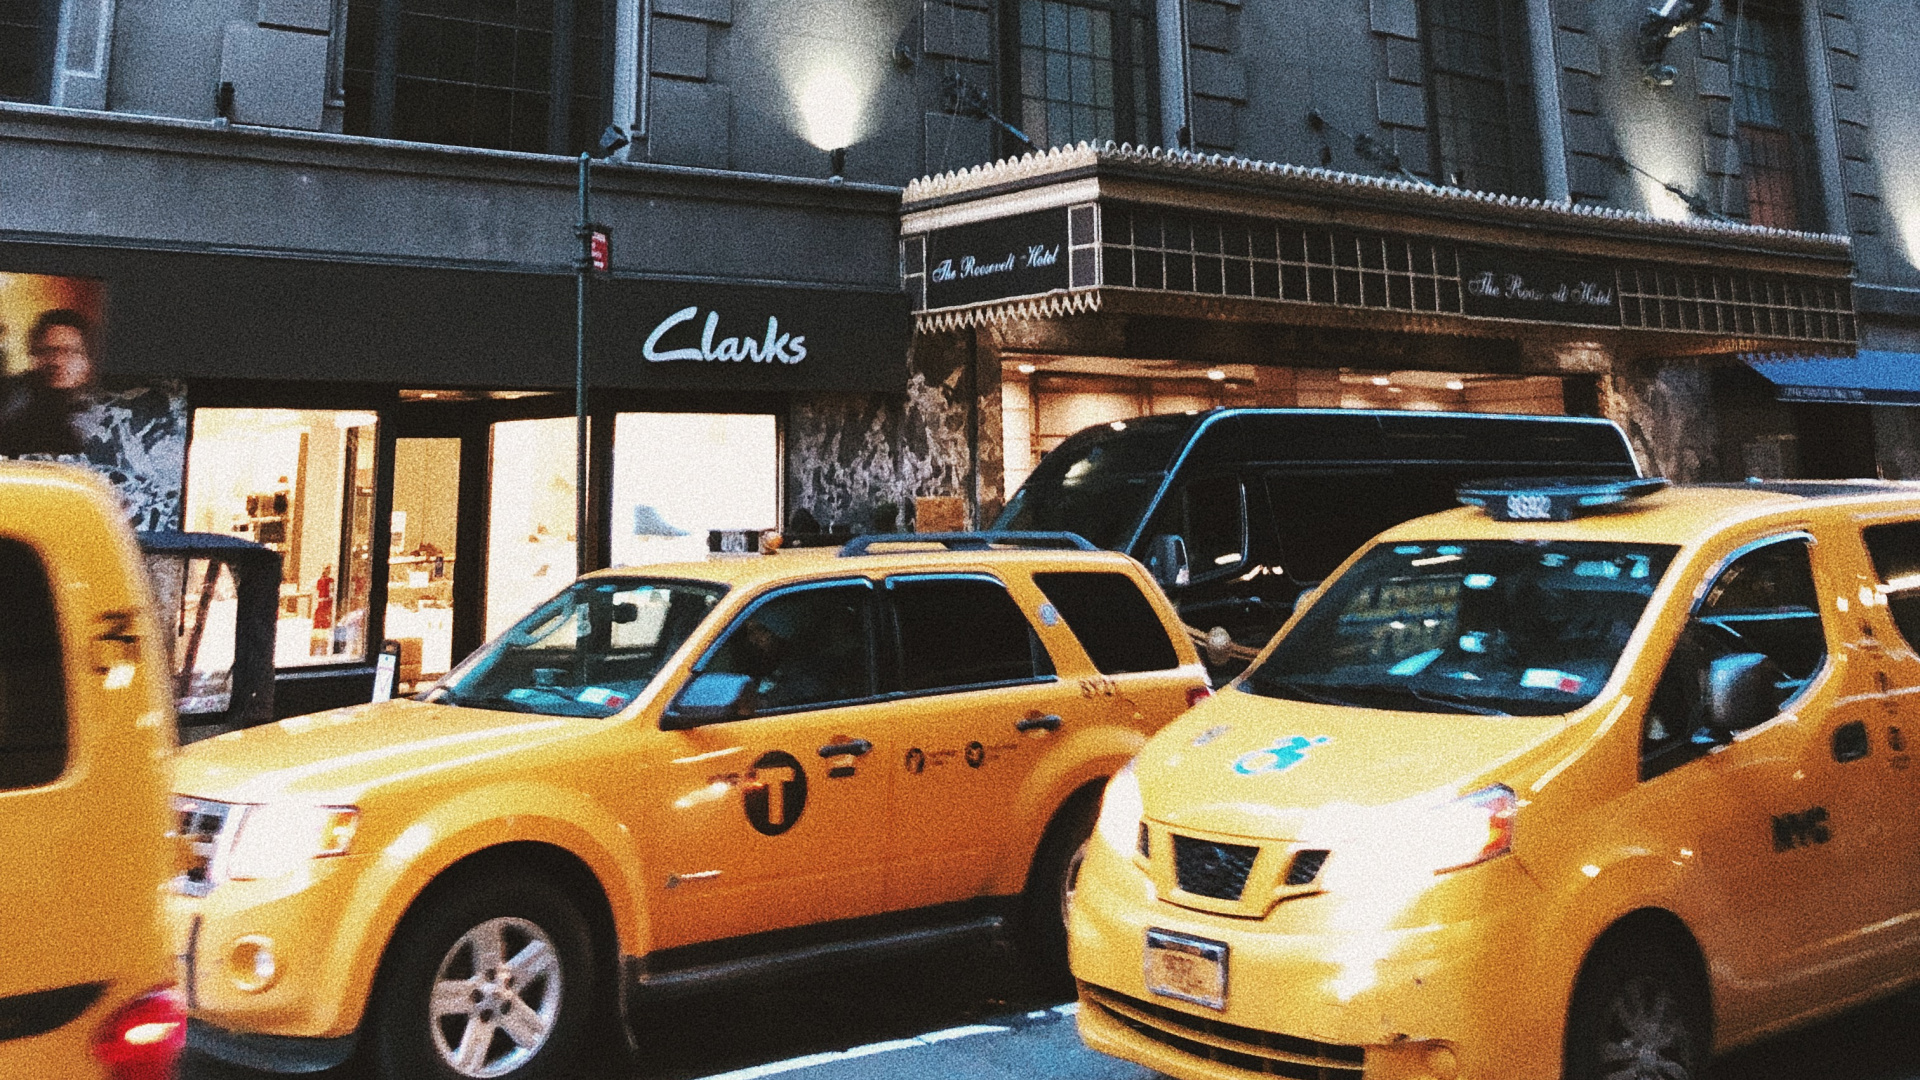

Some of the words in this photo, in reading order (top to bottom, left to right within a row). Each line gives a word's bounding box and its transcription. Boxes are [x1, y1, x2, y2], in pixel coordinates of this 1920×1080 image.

[932, 259, 957, 282] The
[960, 253, 1016, 279] Roosevelt
[1020, 244, 1060, 268] Hotel
[1468, 271, 1500, 298] The
[642, 306, 807, 364] Clarks
